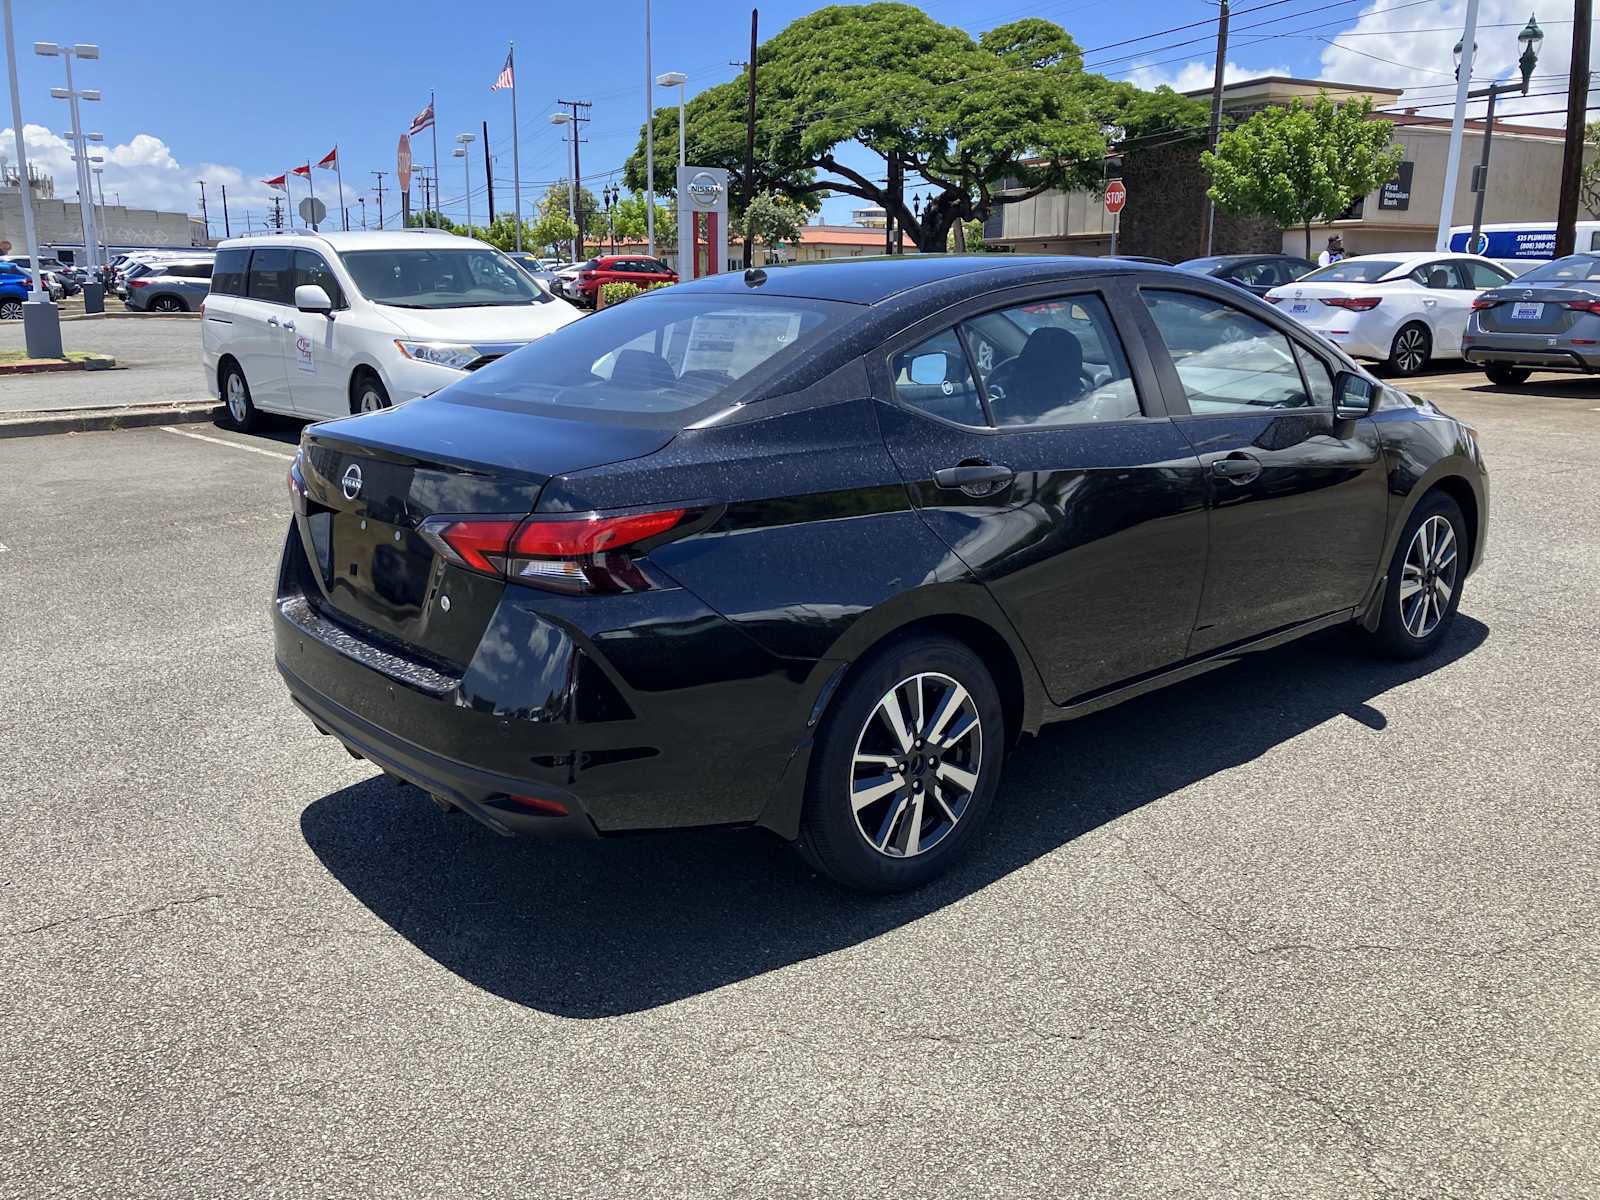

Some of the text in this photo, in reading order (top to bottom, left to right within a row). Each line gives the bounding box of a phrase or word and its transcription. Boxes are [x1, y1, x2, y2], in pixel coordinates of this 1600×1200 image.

[398, 151, 411, 176] STOP
[1385, 183, 1399, 191] First
[1106, 191, 1124, 205] STOP
[1384, 191, 1409, 199] Hawaiian
[1383, 198, 1398, 206] Bank
[1527, 233, 1556, 241] PLUMBING
